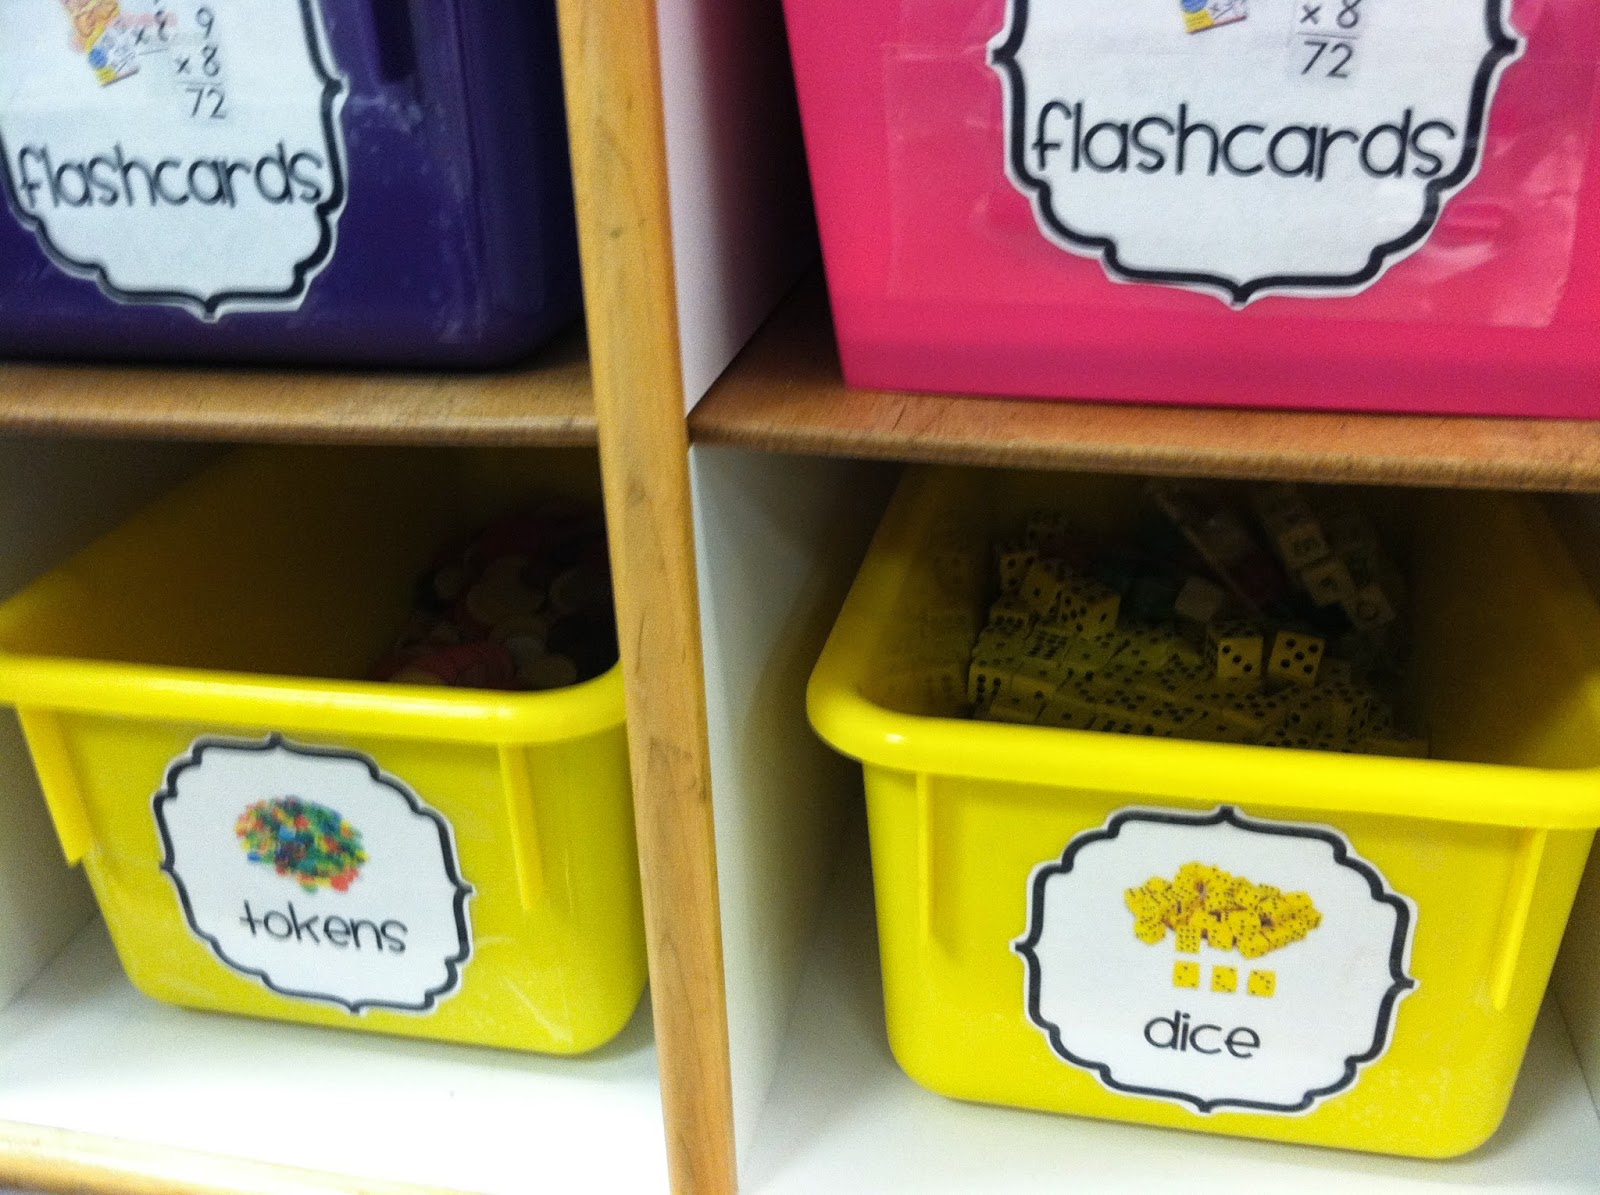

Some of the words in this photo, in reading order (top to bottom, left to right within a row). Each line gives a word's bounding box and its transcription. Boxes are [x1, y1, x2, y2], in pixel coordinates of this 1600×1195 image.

[195, 7, 215, 39] 9
[1336, 0, 1360, 28] 8
[201, 44, 220, 76] 8
[1301, 40, 1352, 78] 72
[185, 87, 227, 119] 72
[1032, 99, 1456, 182] flashcards
[18, 140, 323, 208] flashcards
[240, 899, 409, 953] tokens
[1144, 1009, 1261, 1058] dice
